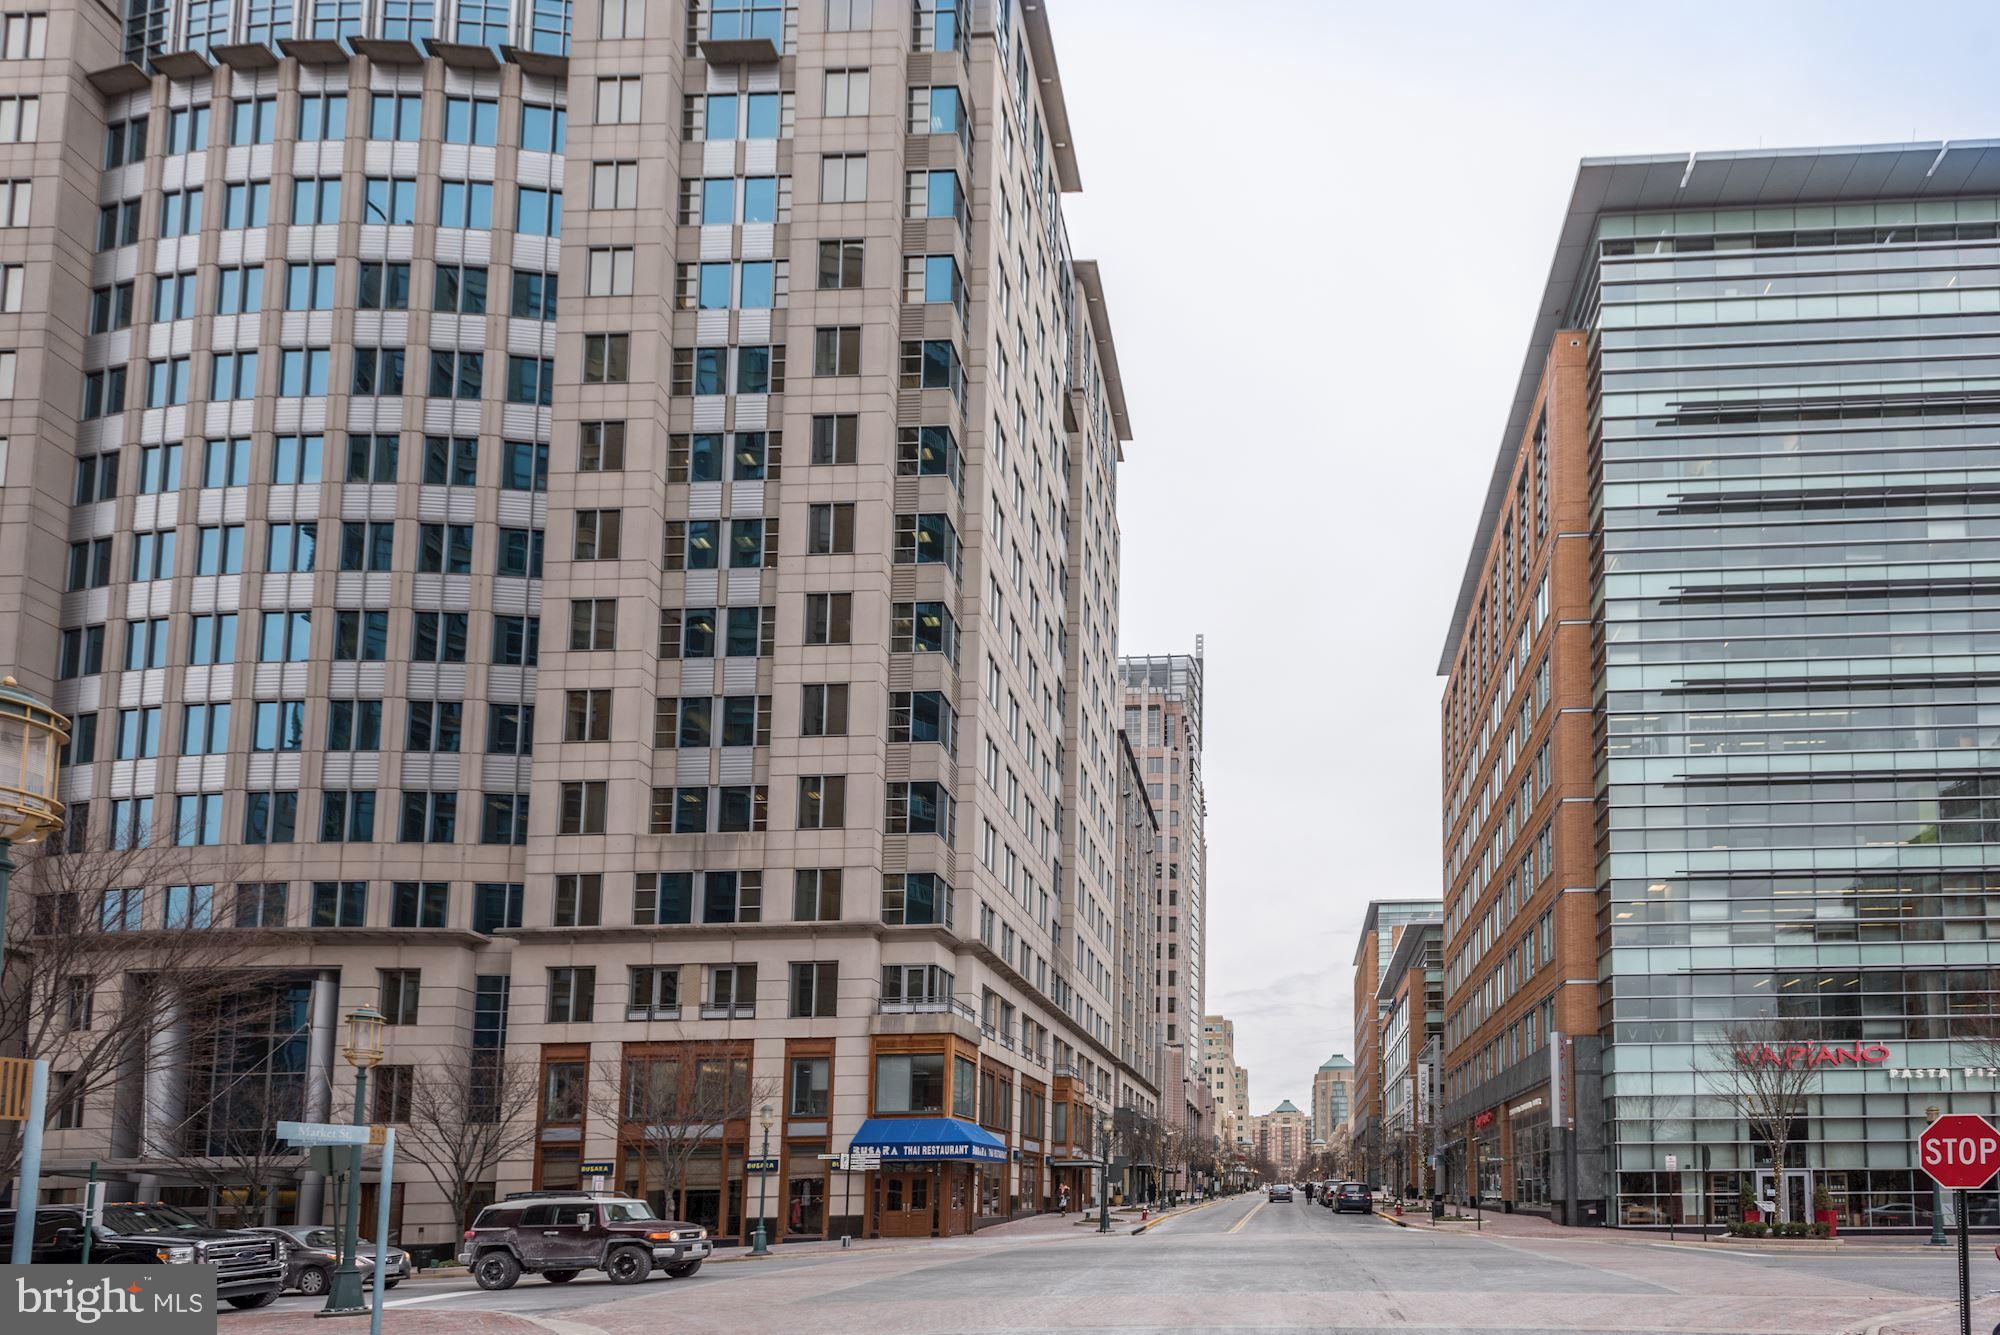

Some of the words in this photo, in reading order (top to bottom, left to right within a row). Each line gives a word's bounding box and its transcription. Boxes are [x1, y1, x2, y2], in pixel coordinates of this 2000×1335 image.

[1735, 1040, 1890, 1069] VAPIANO
[1890, 1069, 1950, 1078] PASTA
[298, 1126, 337, 1138] Market
[852, 1145, 898, 1156] BUSARA
[903, 1146, 920, 1156] THAI
[922, 1145, 969, 1155] RESTAURANT
[1925, 1137, 1997, 1165] STOP
